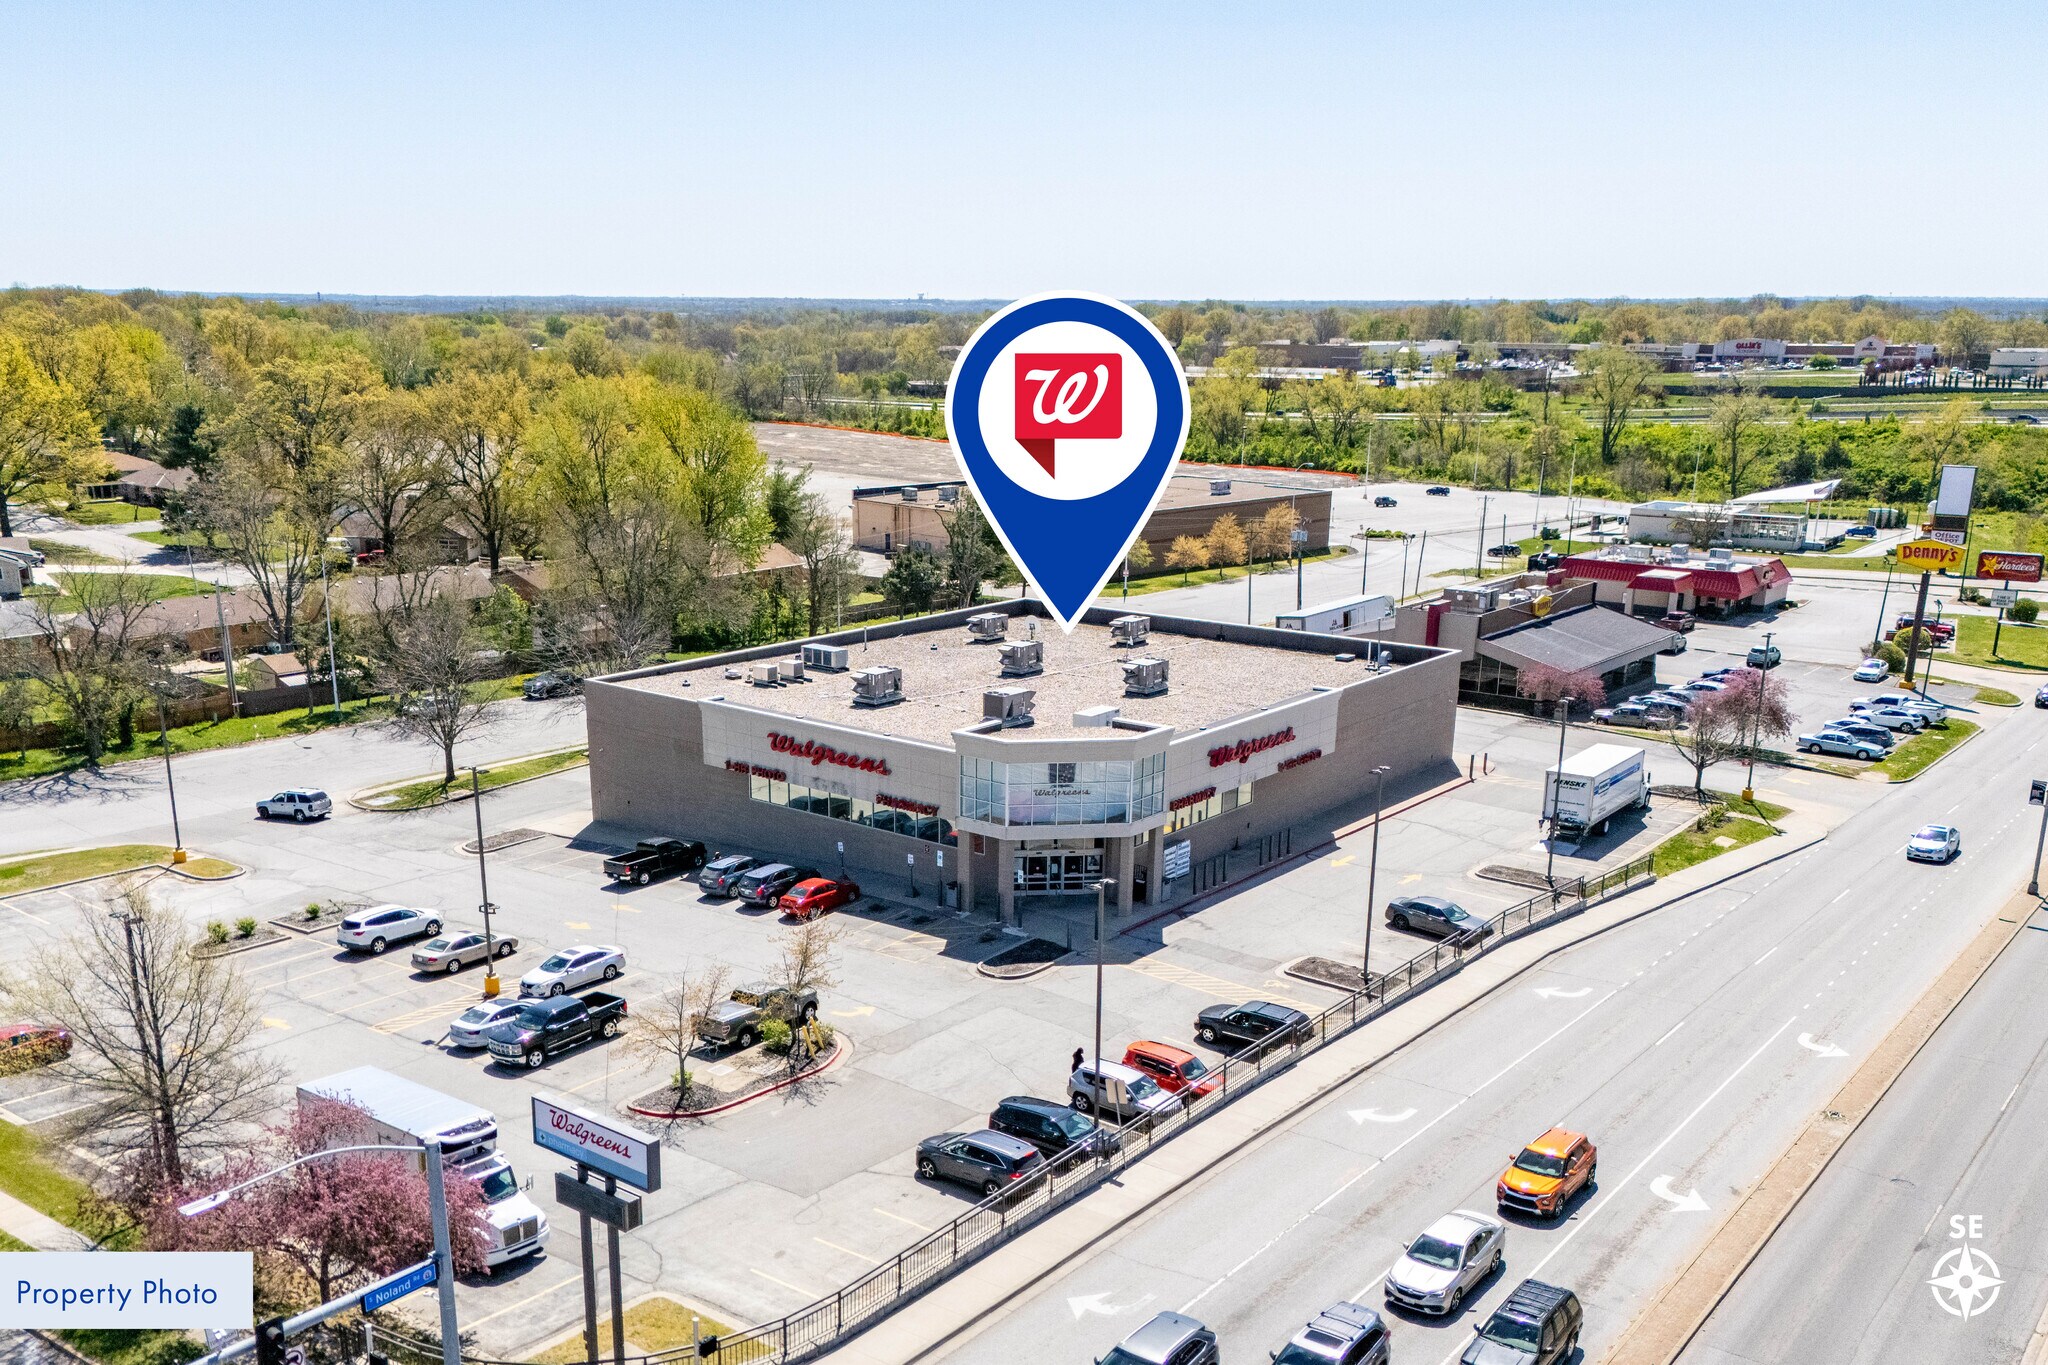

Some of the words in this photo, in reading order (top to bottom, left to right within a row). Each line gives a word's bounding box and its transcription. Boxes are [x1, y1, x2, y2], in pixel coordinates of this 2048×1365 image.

[1902, 545, 1958, 562] Denny's
[767, 732, 892, 776] Walgreens
[1207, 726, 1296, 767] Walgreens
[751, 766, 787, 782] PHOTO
[876, 794, 939, 816] PHARMACY
[1033, 788, 1091, 798] Walgreens
[1170, 787, 1216, 811] PHARMACY
[549, 1108, 631, 1158] Walgreens
[375, 1279, 411, 1304] Noland
